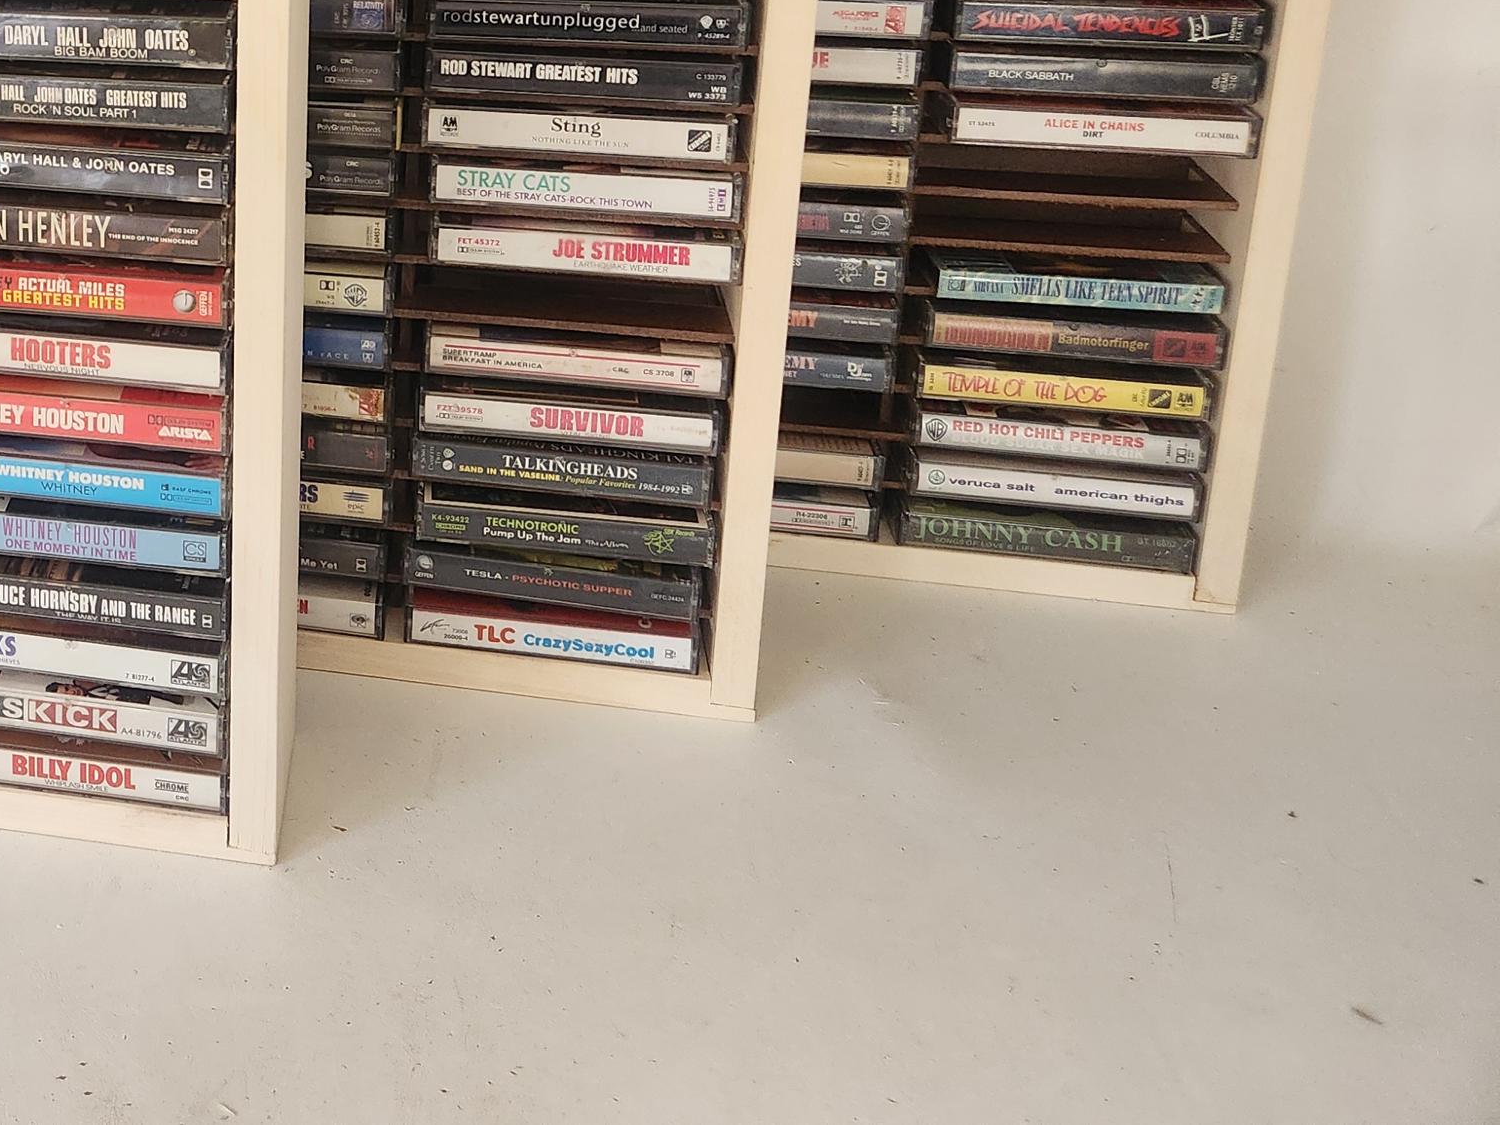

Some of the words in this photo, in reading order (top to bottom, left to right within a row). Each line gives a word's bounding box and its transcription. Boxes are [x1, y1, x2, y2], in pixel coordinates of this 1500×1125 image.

[988, 69, 1023, 79] BLACK
[1024, 71, 1074, 81] SABBATH
[550, 117, 602, 137] Sting
[1044, 119, 1078, 129] ALICE
[1082, 120, 1095, 130] IN
[1099, 121, 1145, 132] CHAINS
[1082, 130, 1104, 138] DIRT
[457, 170, 517, 191] STRAY
[522, 175, 570, 192] CATS
[18, 209, 111, 248] HENLEY
[552, 238, 584, 259] JOE
[591, 239, 690, 266] STRUMMER
[18, 277, 74, 293] ACTUAL
[78, 280, 125, 297] MILES
[10, 337, 111, 369] HOOTERS
[1058, 333, 1149, 352] Badmotorfinger
[158, 425, 212, 440] ARISTA
[529, 407, 644, 437] SURVIVOR
[952, 420, 984, 434] RED
[989, 422, 1019, 436] HOT
[1023, 424, 1063, 440] CHILI
[1069, 430, 1145, 448] PEPPERS
[949, 476, 1001, 490] veruca
[1006, 481, 1036, 492] salt
[1055, 486, 1129, 502] american
[1133, 494, 1184, 508] thighs
[483, 527, 514, 540] Pump
[517, 529, 533, 542] Up
[535, 531, 554, 542] The
[556, 532, 581, 546] Jam
[915, 516, 1030, 545] JOHNNY
[1043, 524, 1123, 553] CASH
[5, 539, 30, 550] ONE
[33, 541, 86, 557] MOMENT
[89, 548, 102, 559] IN
[104, 549, 137, 561] TIME
[30, 588, 97, 614] HORNSBY
[100, 598, 127, 618] AND
[130, 604, 152, 620] THE
[154, 606, 196, 626] RANGE
[474, 625, 516, 644] TLC
[523, 634, 654, 659] CrazySexyCool
[12, 755, 73, 782] BILLY
[80, 761, 136, 790] IDOL
[154, 780, 189, 793] CHROME
